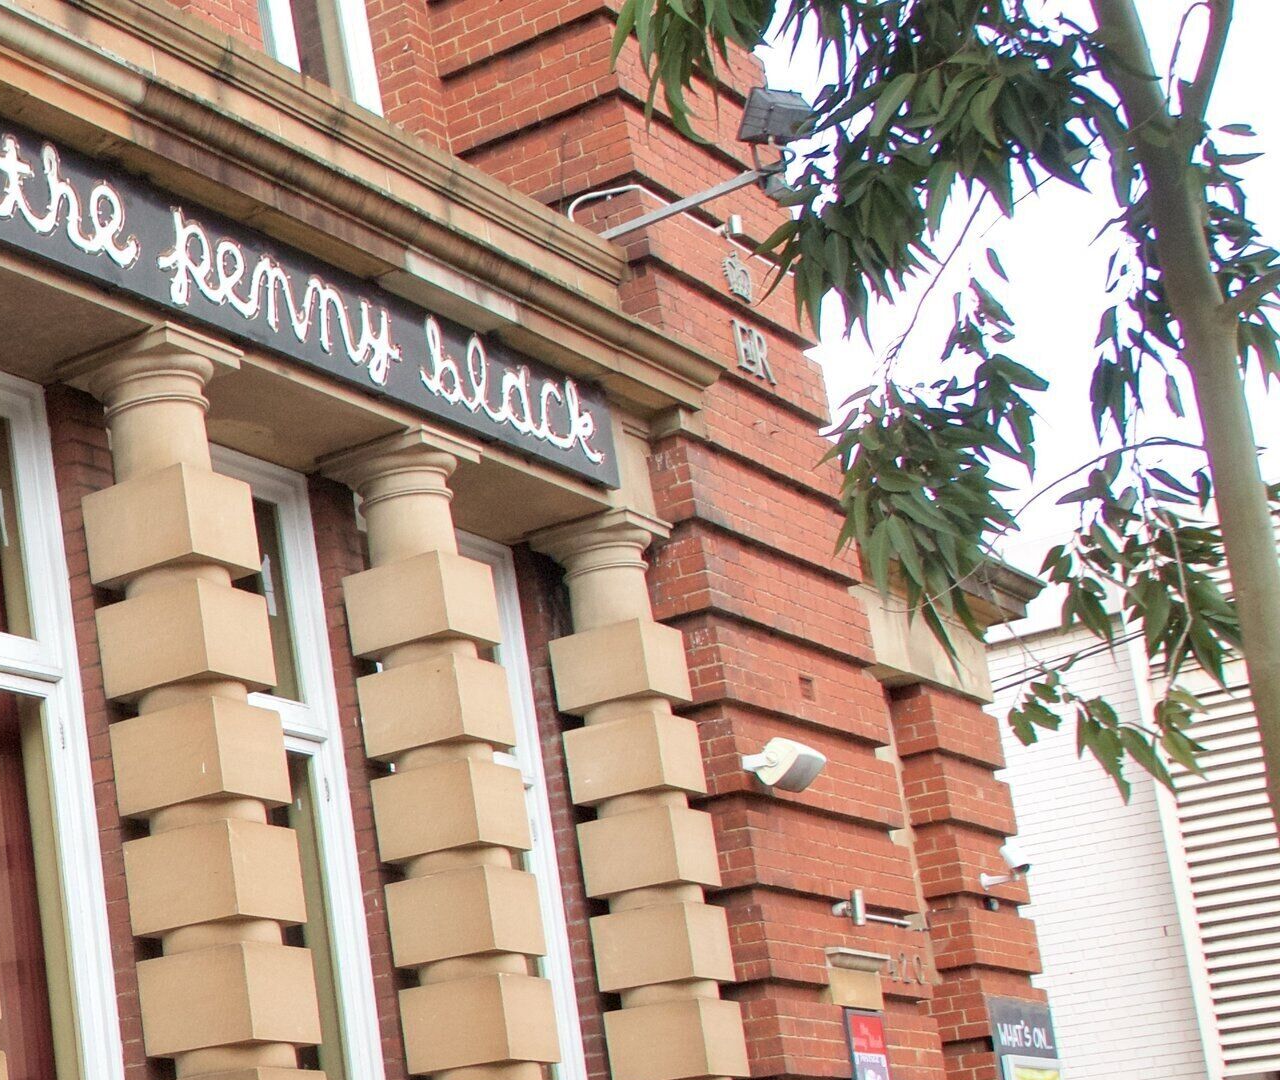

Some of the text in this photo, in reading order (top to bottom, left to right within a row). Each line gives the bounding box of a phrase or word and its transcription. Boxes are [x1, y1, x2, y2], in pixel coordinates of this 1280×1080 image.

[157, 205, 401, 386] penny
[420, 314, 605, 465] black
[997, 1020, 1032, 1047] WHAT'S
